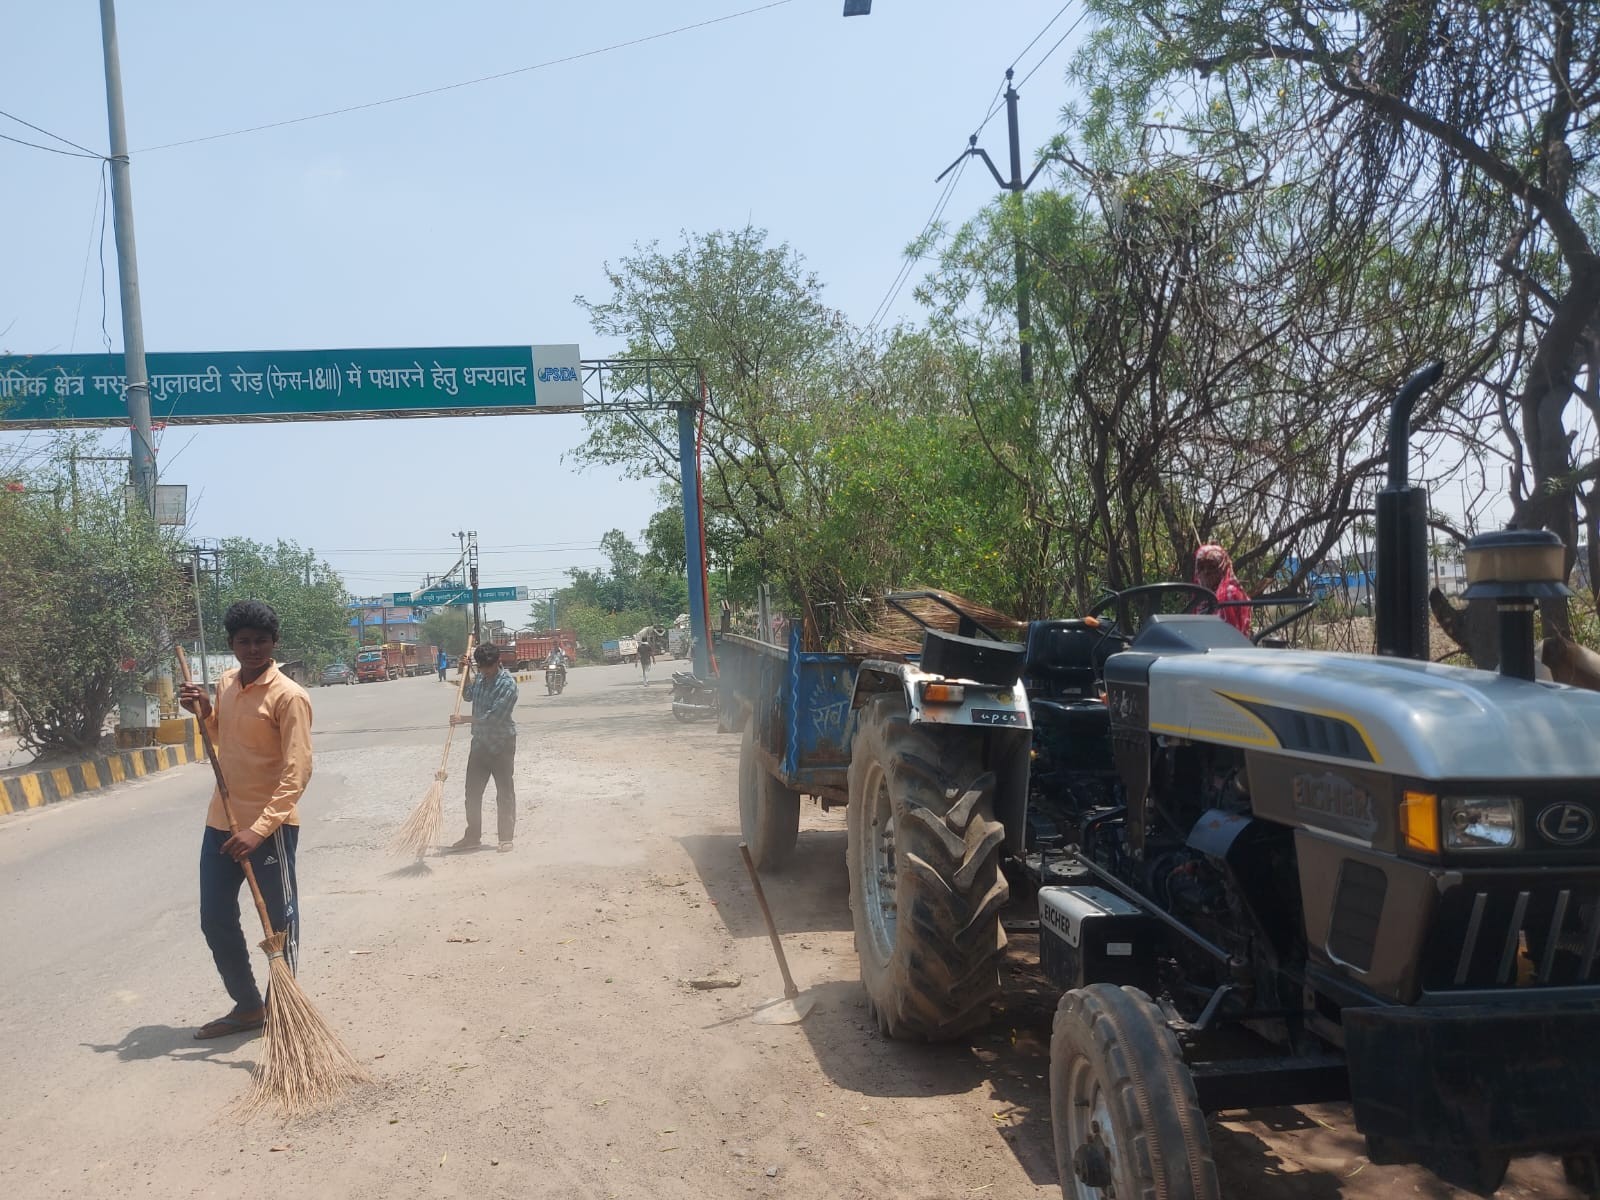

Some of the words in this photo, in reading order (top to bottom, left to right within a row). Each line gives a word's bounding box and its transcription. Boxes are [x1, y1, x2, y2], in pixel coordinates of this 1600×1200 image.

[54, 367, 85, 396] क्षेत्र
[151, 364, 222, 401] गुलावटी
[346, 361, 363, 389] में
[367, 360, 425, 390] पधारने
[430, 360, 458, 396] हेतु
[463, 365, 527, 388] धन्यवाद
[1044, 903, 1071, 937] EICHER
